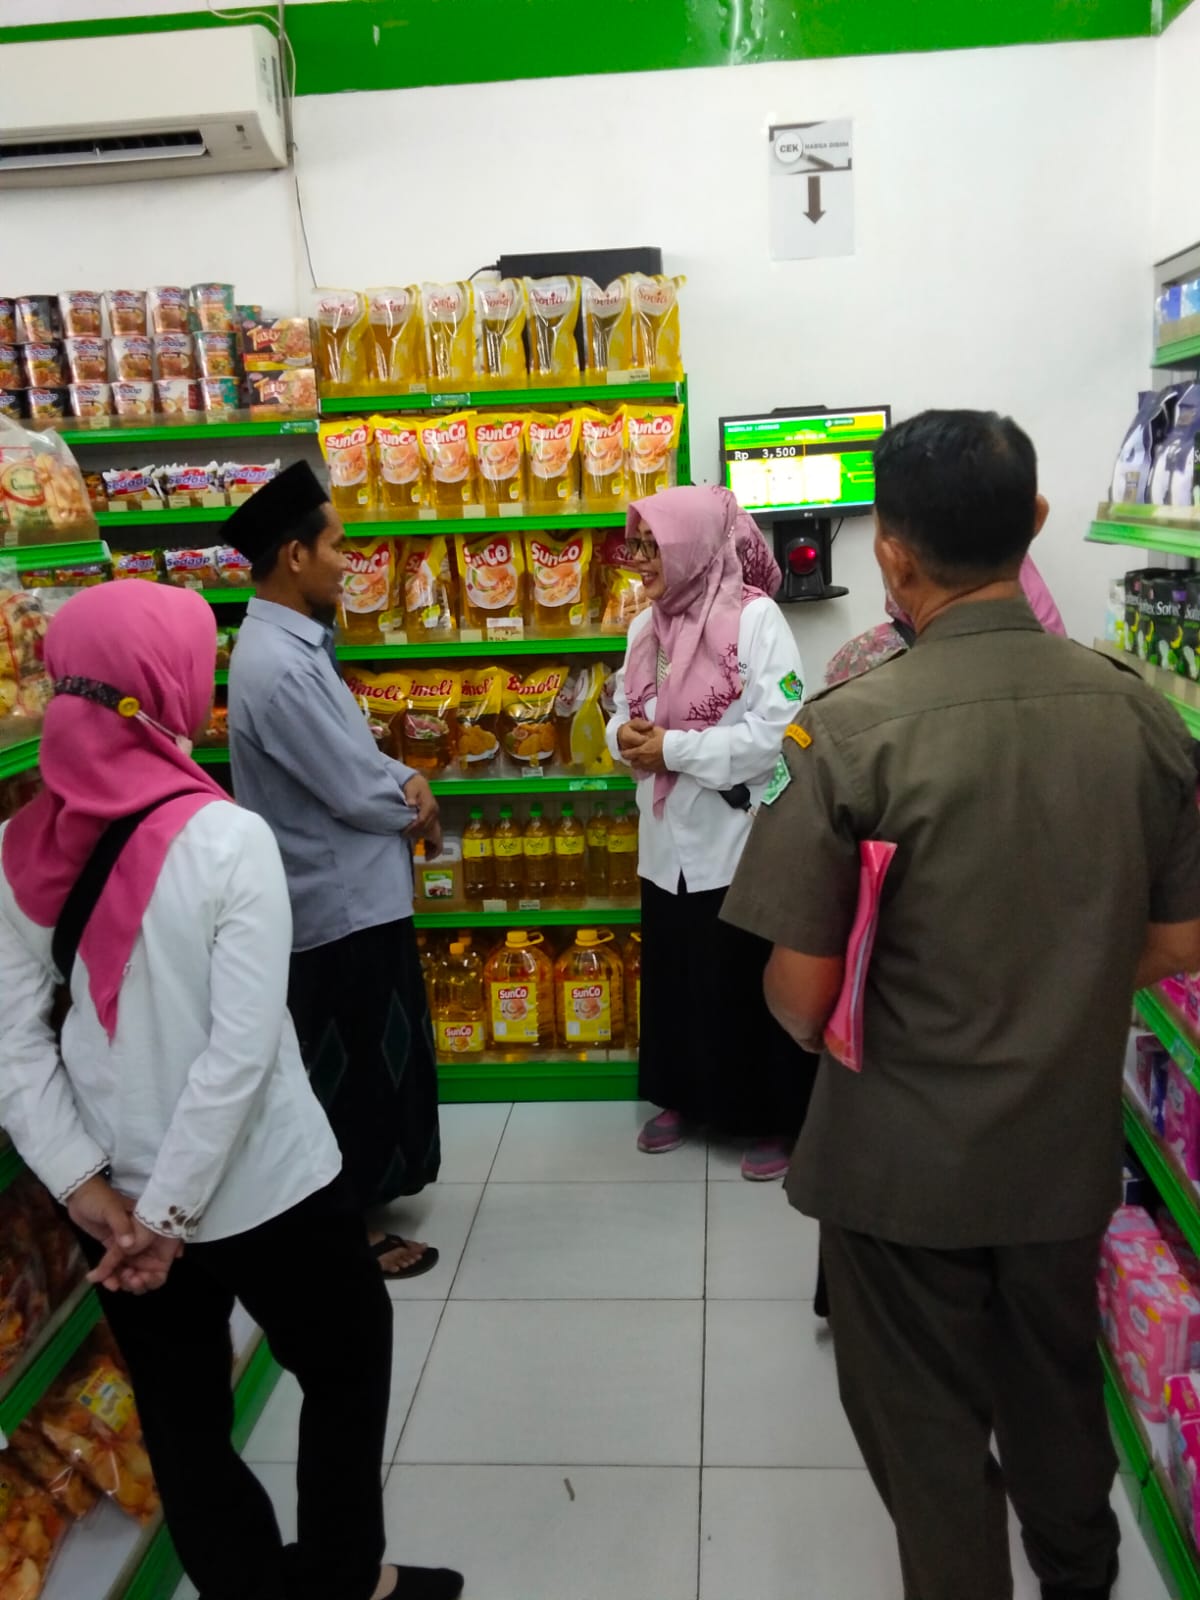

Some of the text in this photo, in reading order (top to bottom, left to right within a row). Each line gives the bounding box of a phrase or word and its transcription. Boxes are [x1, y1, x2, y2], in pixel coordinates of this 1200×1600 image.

[779, 143, 800, 153] CEK
[423, 422, 466, 444] SunCo
[476, 422, 521, 441] SunCo
[529, 422, 570, 440] SunCo
[582, 419, 621, 439] SunCo
[628, 417, 669, 435] SunCo
[326, 428, 367, 447] SunCo
[375, 428, 416, 446] SunCo
[734, 446, 796, 461] Rp 3,500
[166, 556, 210, 567] Sedaap
[532, 543, 580, 567] SunCo
[410, 680, 453, 696] imoli
[499, 986, 527, 998] SunCo
[573, 986, 601, 998] SunCo
[446, 1025, 472, 1037] SunCo
